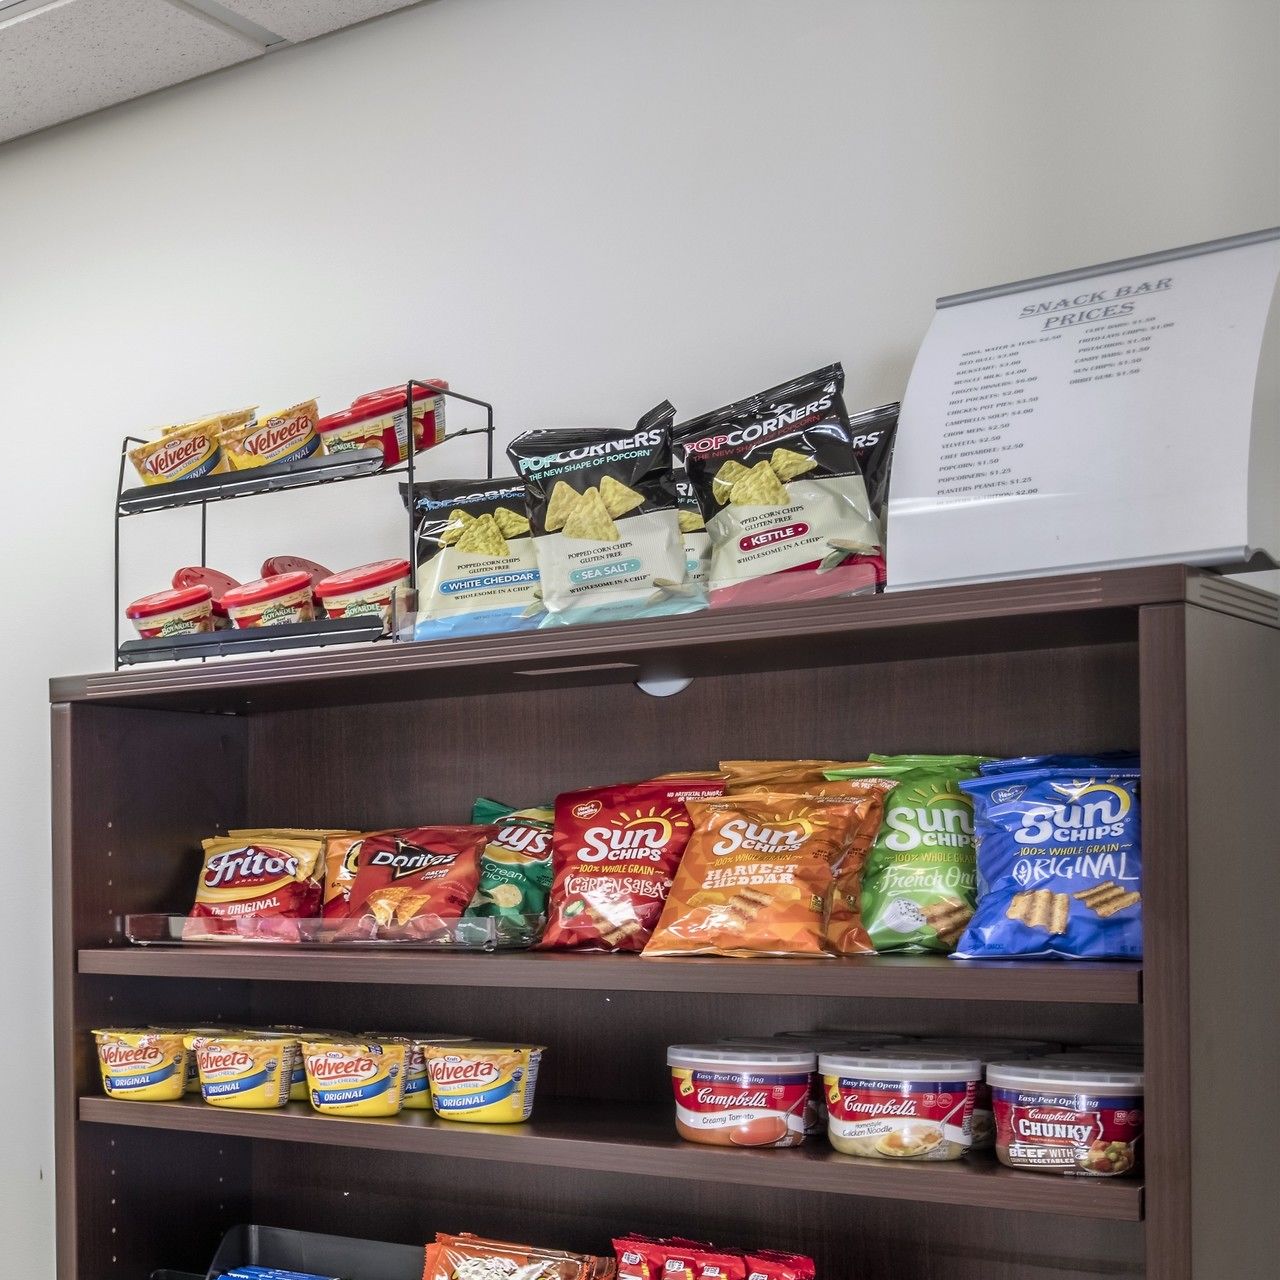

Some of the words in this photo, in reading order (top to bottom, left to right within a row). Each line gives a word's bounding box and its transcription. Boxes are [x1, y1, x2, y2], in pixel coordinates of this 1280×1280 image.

[1018, 289, 1108, 318] SNACK
[1114, 277, 1173, 299] BAR
[1041, 301, 1136, 331] PRICES
[683, 394, 832, 454] POPCORNERS
[247, 414, 309, 456] Velveeta
[148, 434, 207, 475] Velveeta
[518, 431, 662, 476] POPCORNERS
[712, 448, 735, 460] NEW
[529, 473, 543, 482] THE
[543, 467, 564, 479] NEW
[564, 461, 592, 473] SHAPE
[592, 457, 605, 467] OF
[606, 449, 651, 464] POPCORN
[1015, 488, 1039, 496] $2.00
[744, 520, 772, 532] GLUTEN
[772, 515, 794, 526] FREE
[759, 509, 782, 521] CORN
[751, 527, 795, 547] KETTLE
[579, 554, 605, 565] GLUTEN
[592, 546, 613, 556] CORN
[736, 547, 782, 565] WHOLESOME
[581, 567, 601, 580] SEA
[603, 562, 629, 575] SALT
[448, 580, 482, 591] WHITE
[483, 573, 534, 586] CHEDDAR
[569, 580, 613, 595] WHOLESOME
[454, 590, 497, 601] WHOLESOME
[885, 806, 974, 851] Sun
[1014, 795, 1123, 844] Sun
[712, 818, 811, 857] Sun
[1053, 822, 1125, 842] CHIPS
[577, 820, 669, 863] Sun
[740, 840, 802, 853] CHIPS
[1019, 847, 1045, 857] 100%
[1049, 845, 1085, 856] WHOLE
[1086, 842, 1120, 854] GRAIN
[372, 850, 460, 867] Doritos
[607, 848, 662, 862] CHIPS
[921, 852, 953, 863] WHOLE
[205, 847, 299, 889] Fritos
[485, 863, 524, 882] Cream
[579, 865, 600, 873] 100%
[601, 864, 628, 873] WHOLE
[628, 864, 655, 875] GRAIN
[706, 864, 799, 881] HARVEST
[1011, 852, 1140, 887] ORIGINAL
[701, 873, 796, 890] CHEDDAR
[880, 866, 943, 892] French
[211, 906, 225, 916] The
[227, 896, 281, 915] ORIGINAL
[102, 1046, 159, 1067] Velveeta
[197, 1051, 250, 1070] Velveeta
[308, 1056, 374, 1079] Velveeta
[429, 1061, 495, 1083] Velveeta
[115, 1076, 151, 1087] ORIGINAL
[208, 1082, 241, 1094] ORIGINAL
[858, 1080, 876, 1088] Peel
[323, 1089, 364, 1102] ORIGINAL
[442, 1095, 486, 1108] ORIGINAL
[697, 1087, 769, 1109] Campbell's
[843, 1094, 918, 1117] Campbell's
[1027, 1107, 1077, 1122] Campbell's
[702, 1114, 727, 1125] Creamy
[867, 1124, 893, 1136] Noodle
[1018, 1118, 1093, 1143] CHUNKY
[1009, 1147, 1048, 1158] BEEF
[1048, 1148, 1074, 1158] WITH
